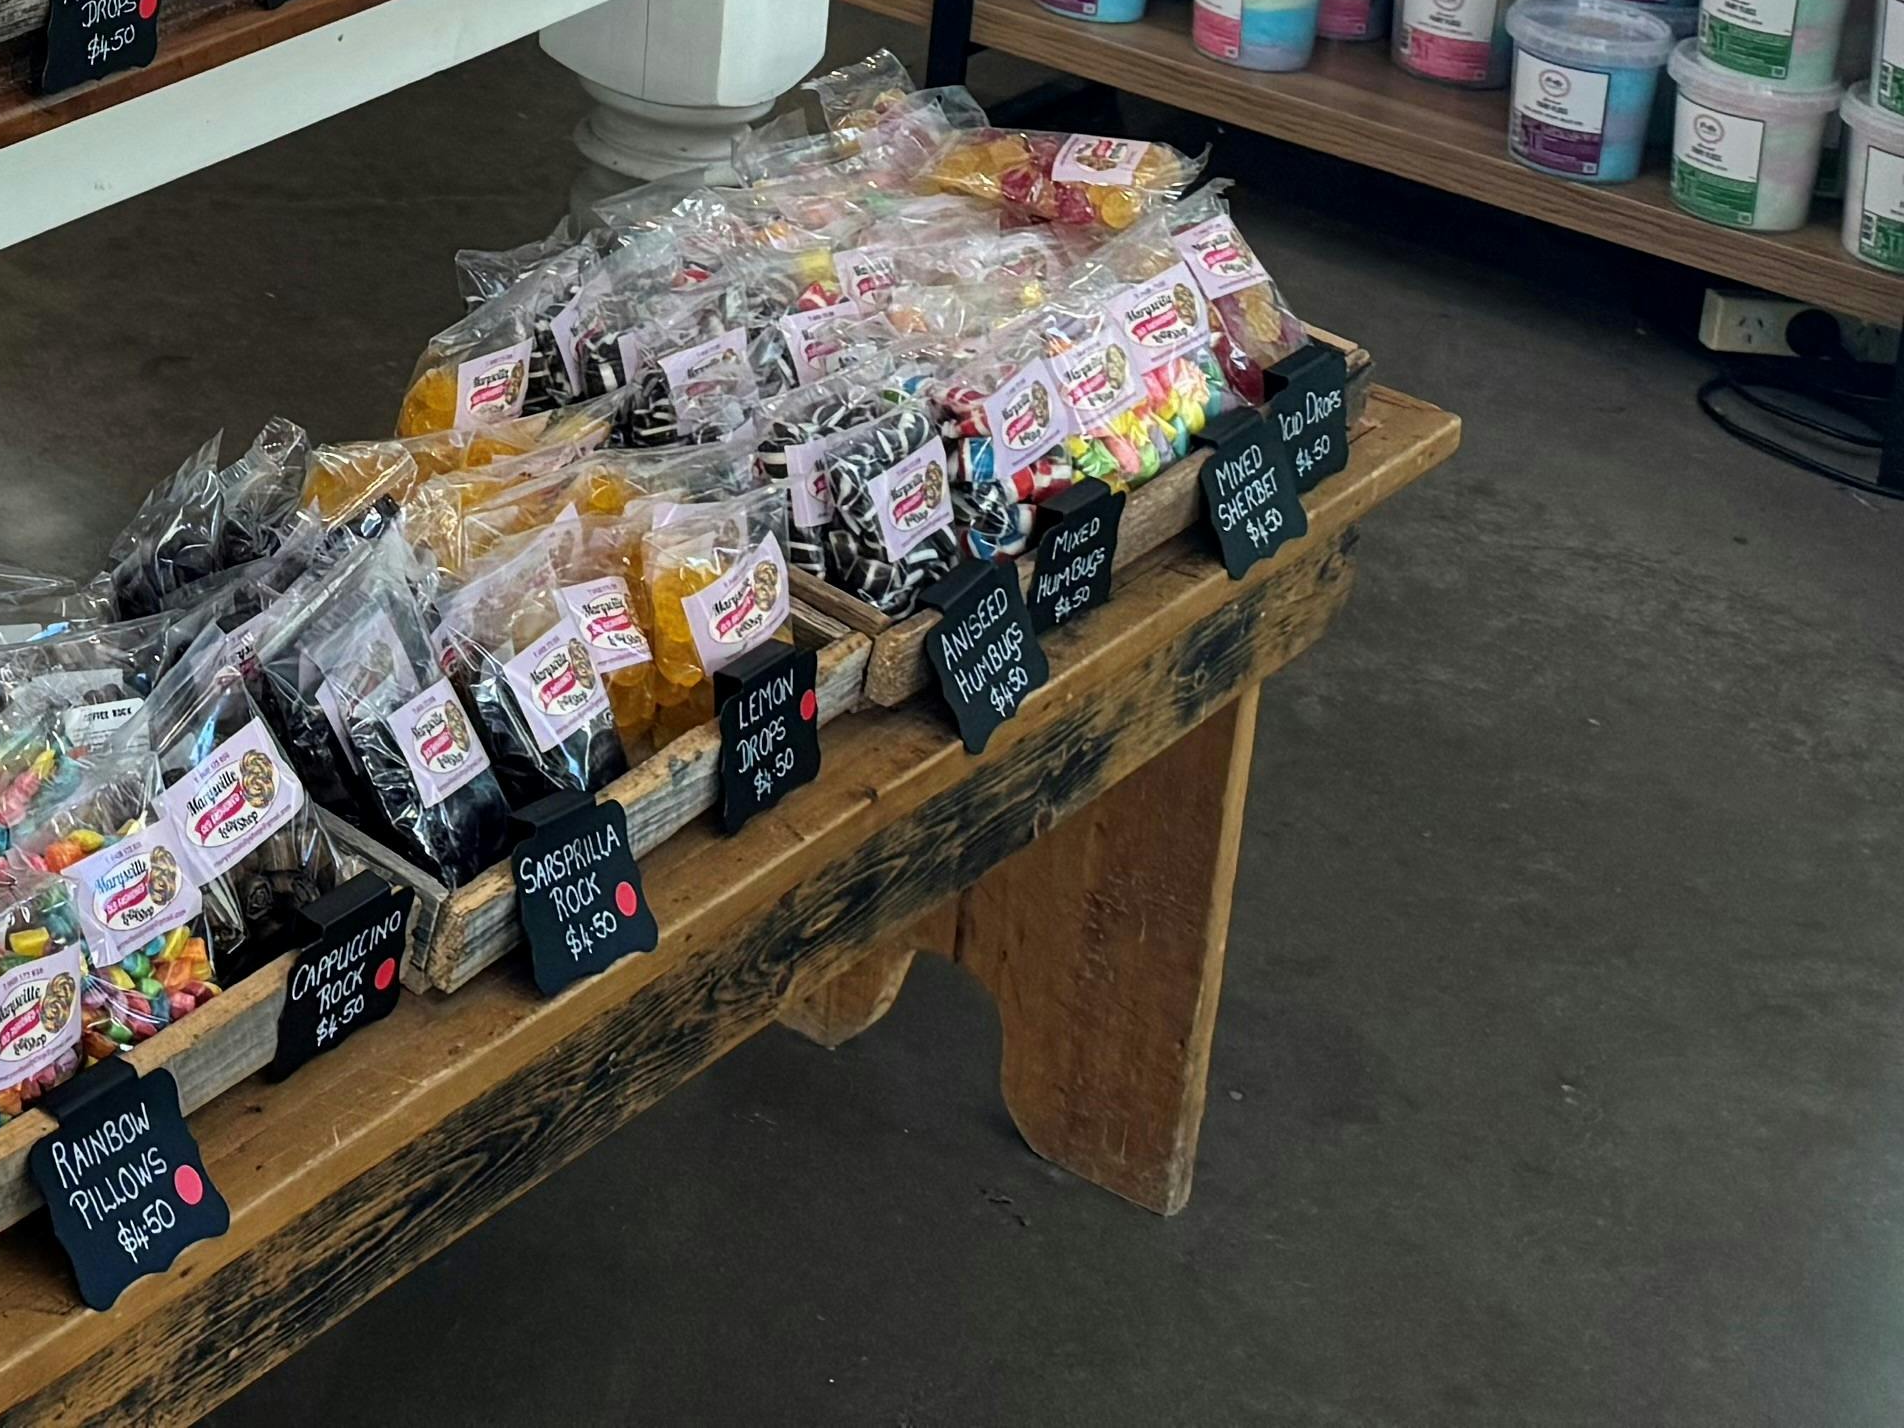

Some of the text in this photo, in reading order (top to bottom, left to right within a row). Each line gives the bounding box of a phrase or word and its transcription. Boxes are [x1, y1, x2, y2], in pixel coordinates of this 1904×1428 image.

[1214, 443, 1264, 496] MIXED
[1216, 468, 1280, 536] SHERBET
[1034, 545, 1107, 602] HUMBUGS
[937, 585, 1011, 667] ANISEED
[952, 624, 1026, 704] HUMBUGS
[737, 668, 796, 731] LEMON
[737, 720, 788, 775] DROPS
[187, 770, 239, 816] Marysville
[96, 859, 148, 894] Marysville
[518, 822, 622, 896] SARSPRILLA
[289, 909, 403, 1002] CAPPUCCINO
[49, 1101, 152, 1191] RAINBOW
[69, 1145, 170, 1232] PILLOWS
